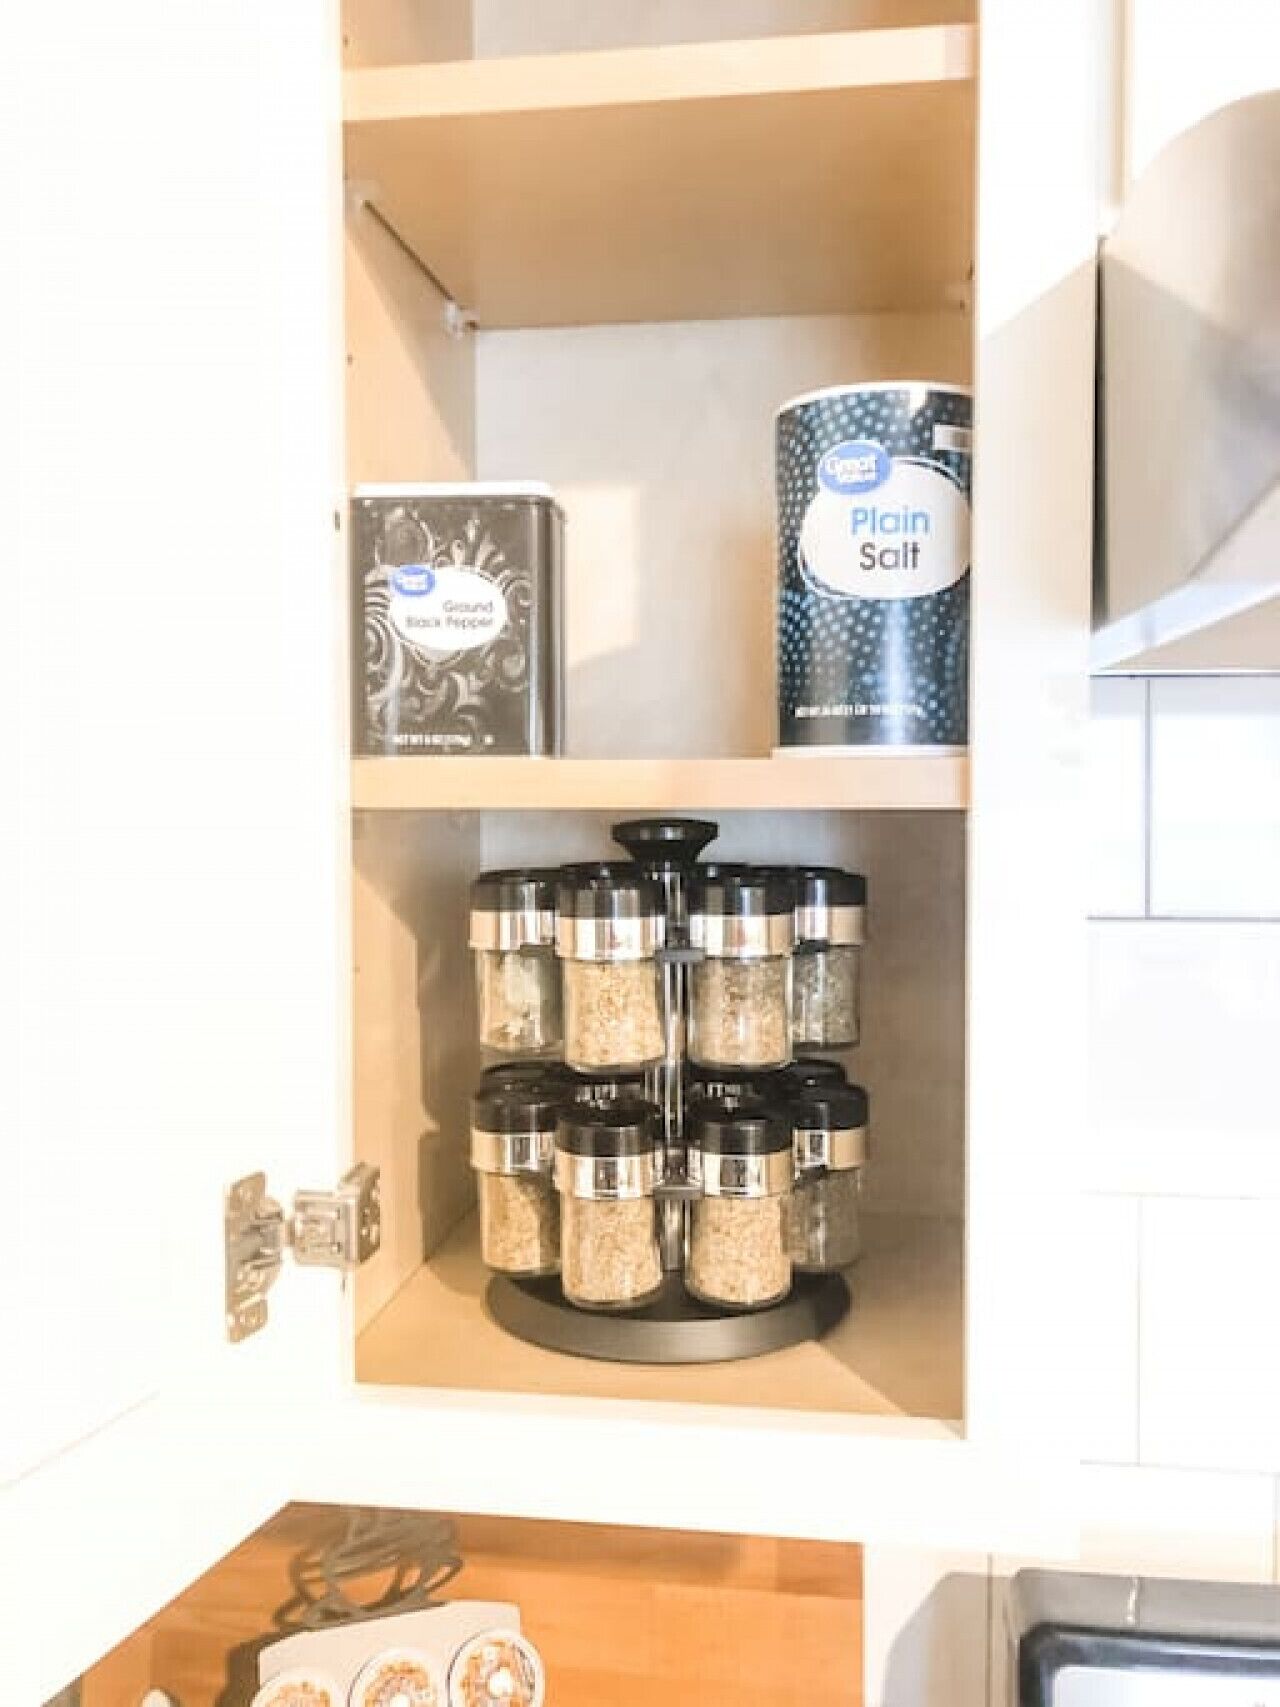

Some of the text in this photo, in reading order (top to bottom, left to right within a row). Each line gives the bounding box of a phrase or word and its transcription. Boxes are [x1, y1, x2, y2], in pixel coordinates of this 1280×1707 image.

[851, 506, 930, 535] Plain
[859, 541, 920, 571] Salt
[443, 600, 493, 613] Ground
[405, 616, 494, 631] Black Pepper
